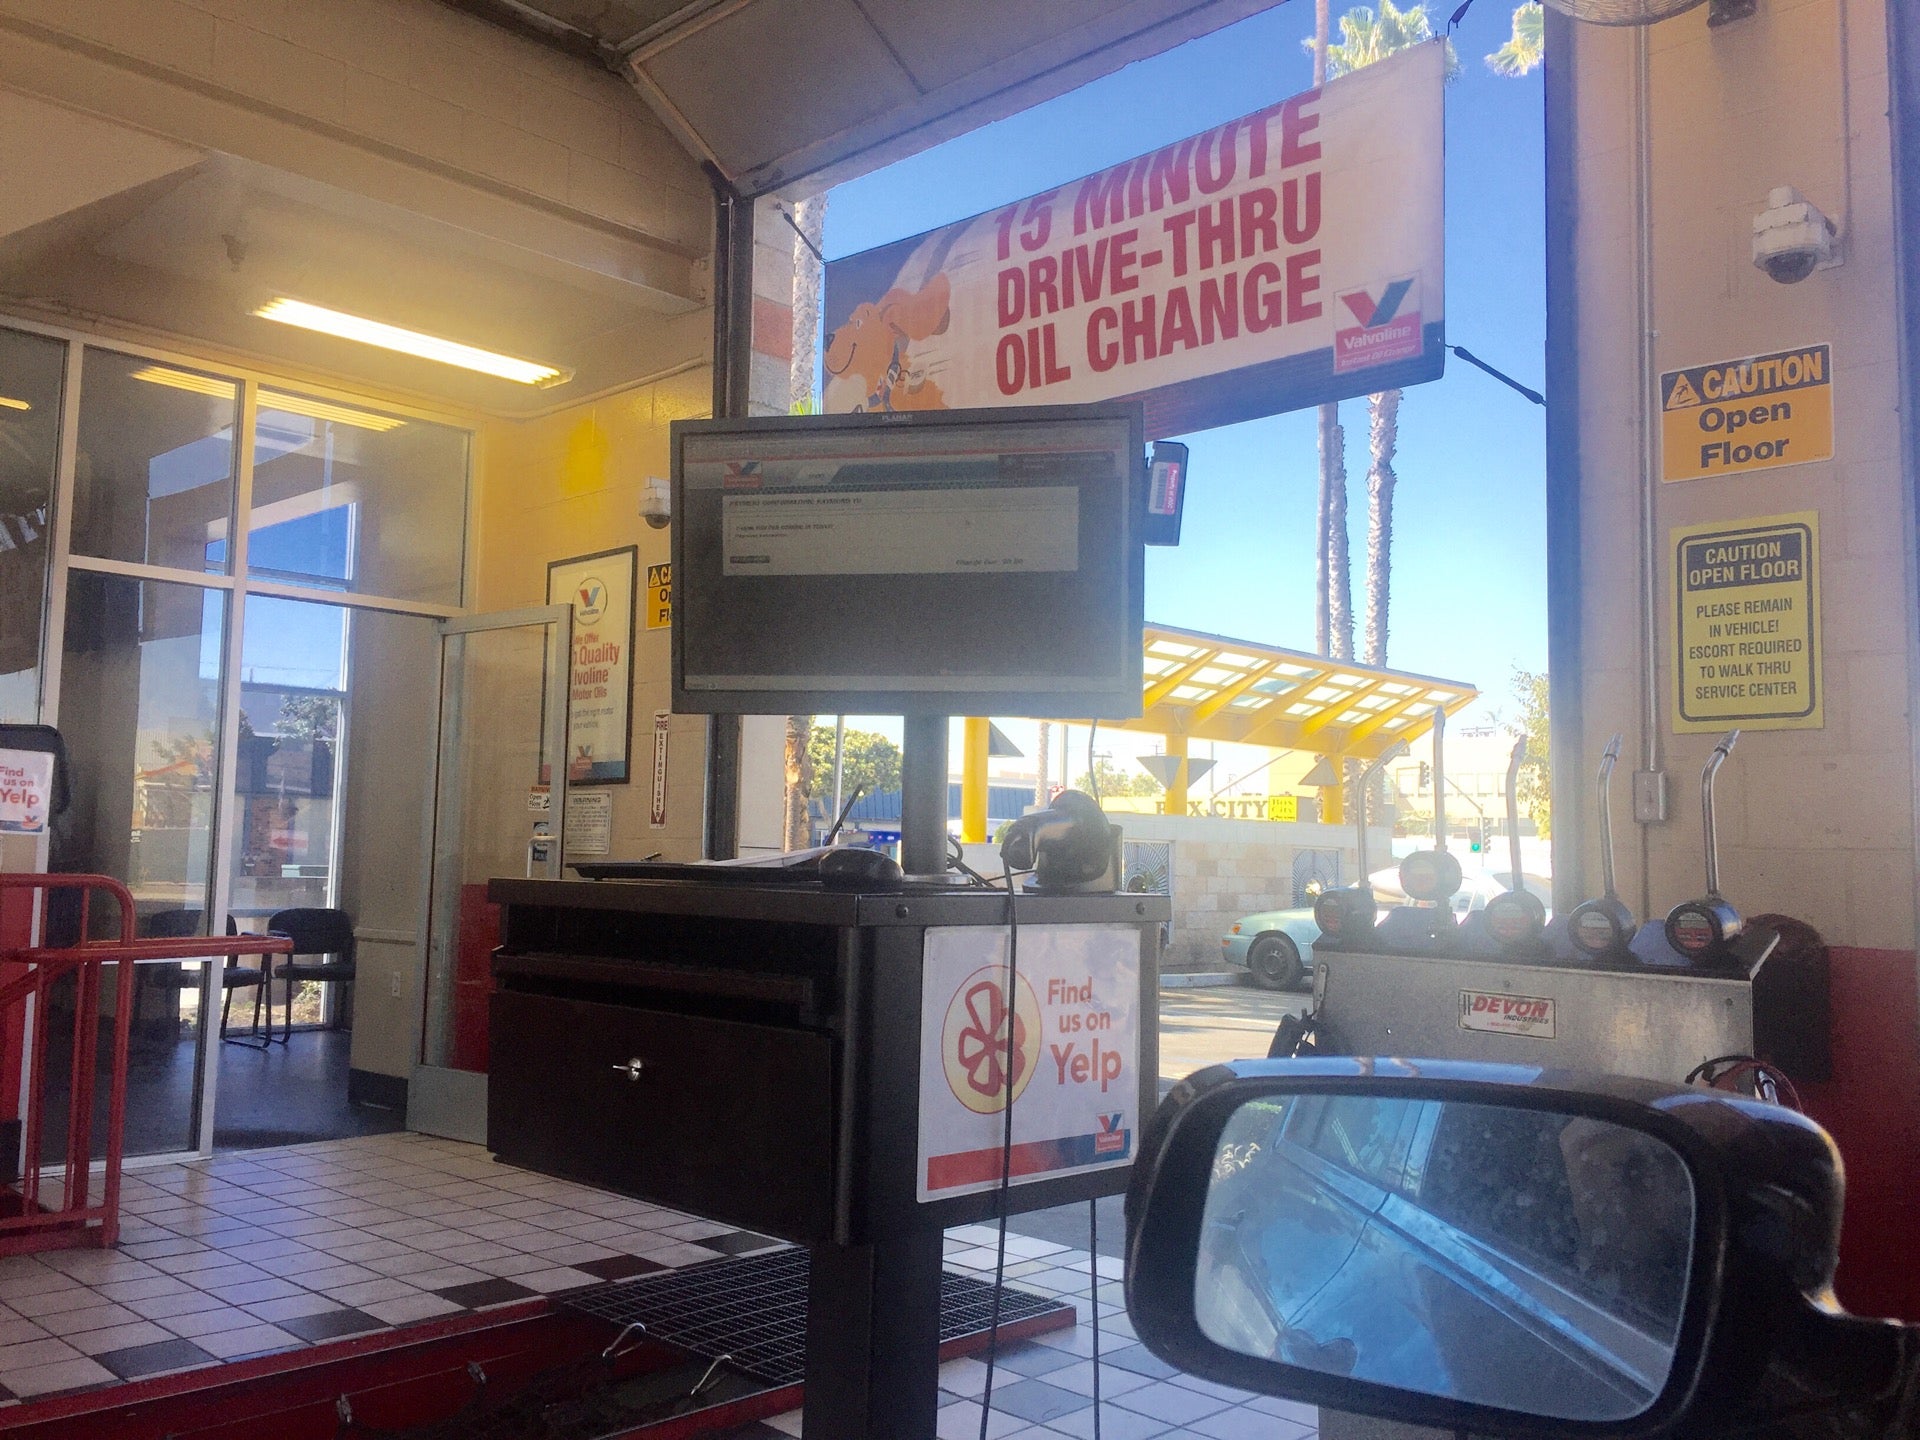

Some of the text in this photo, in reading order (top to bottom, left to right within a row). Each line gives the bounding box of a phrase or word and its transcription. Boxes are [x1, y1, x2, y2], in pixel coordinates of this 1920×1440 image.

[993, 89, 1322, 262] 15 MINUTE
[997, 171, 1322, 329] DRIVE-THRU
[995, 248, 1323, 396] OIL CHANGE
[1343, 326, 1412, 350] Valvoline
[1702, 351, 1823, 400] CAUTION
[1698, 402, 1792, 434] Open
[1700, 438, 1790, 469] Floor
[1705, 541, 1781, 565] CAUTION
[1690, 559, 1799, 586] OPEN FLOOR
[1696, 597, 1792, 618] PLEASE REMAIN
[1709, 619, 1779, 637] IN VEHICLE!
[579, 641, 620, 666] Quality
[1689, 639, 1802, 659] ESCORT REQUIRED
[573, 666, 609, 686] lvoline
[1700, 660, 1791, 678] TO WALK THRU
[1696, 681, 1797, 700] SERVICE CENTER
[656, 720, 668, 731] FIRE
[655, 733, 665, 818] EXTINGUISHER
[0, 788, 40, 809] Yelp
[1215, 800, 1268, 818] CITY
[1047, 977, 1093, 1005] Find
[1471, 994, 1549, 1018] DEVON
[1059, 1010, 1111, 1033] us on
[1503, 1014, 1550, 1025] INDUSTRIES
[1050, 1038, 1122, 1093] Yelp
